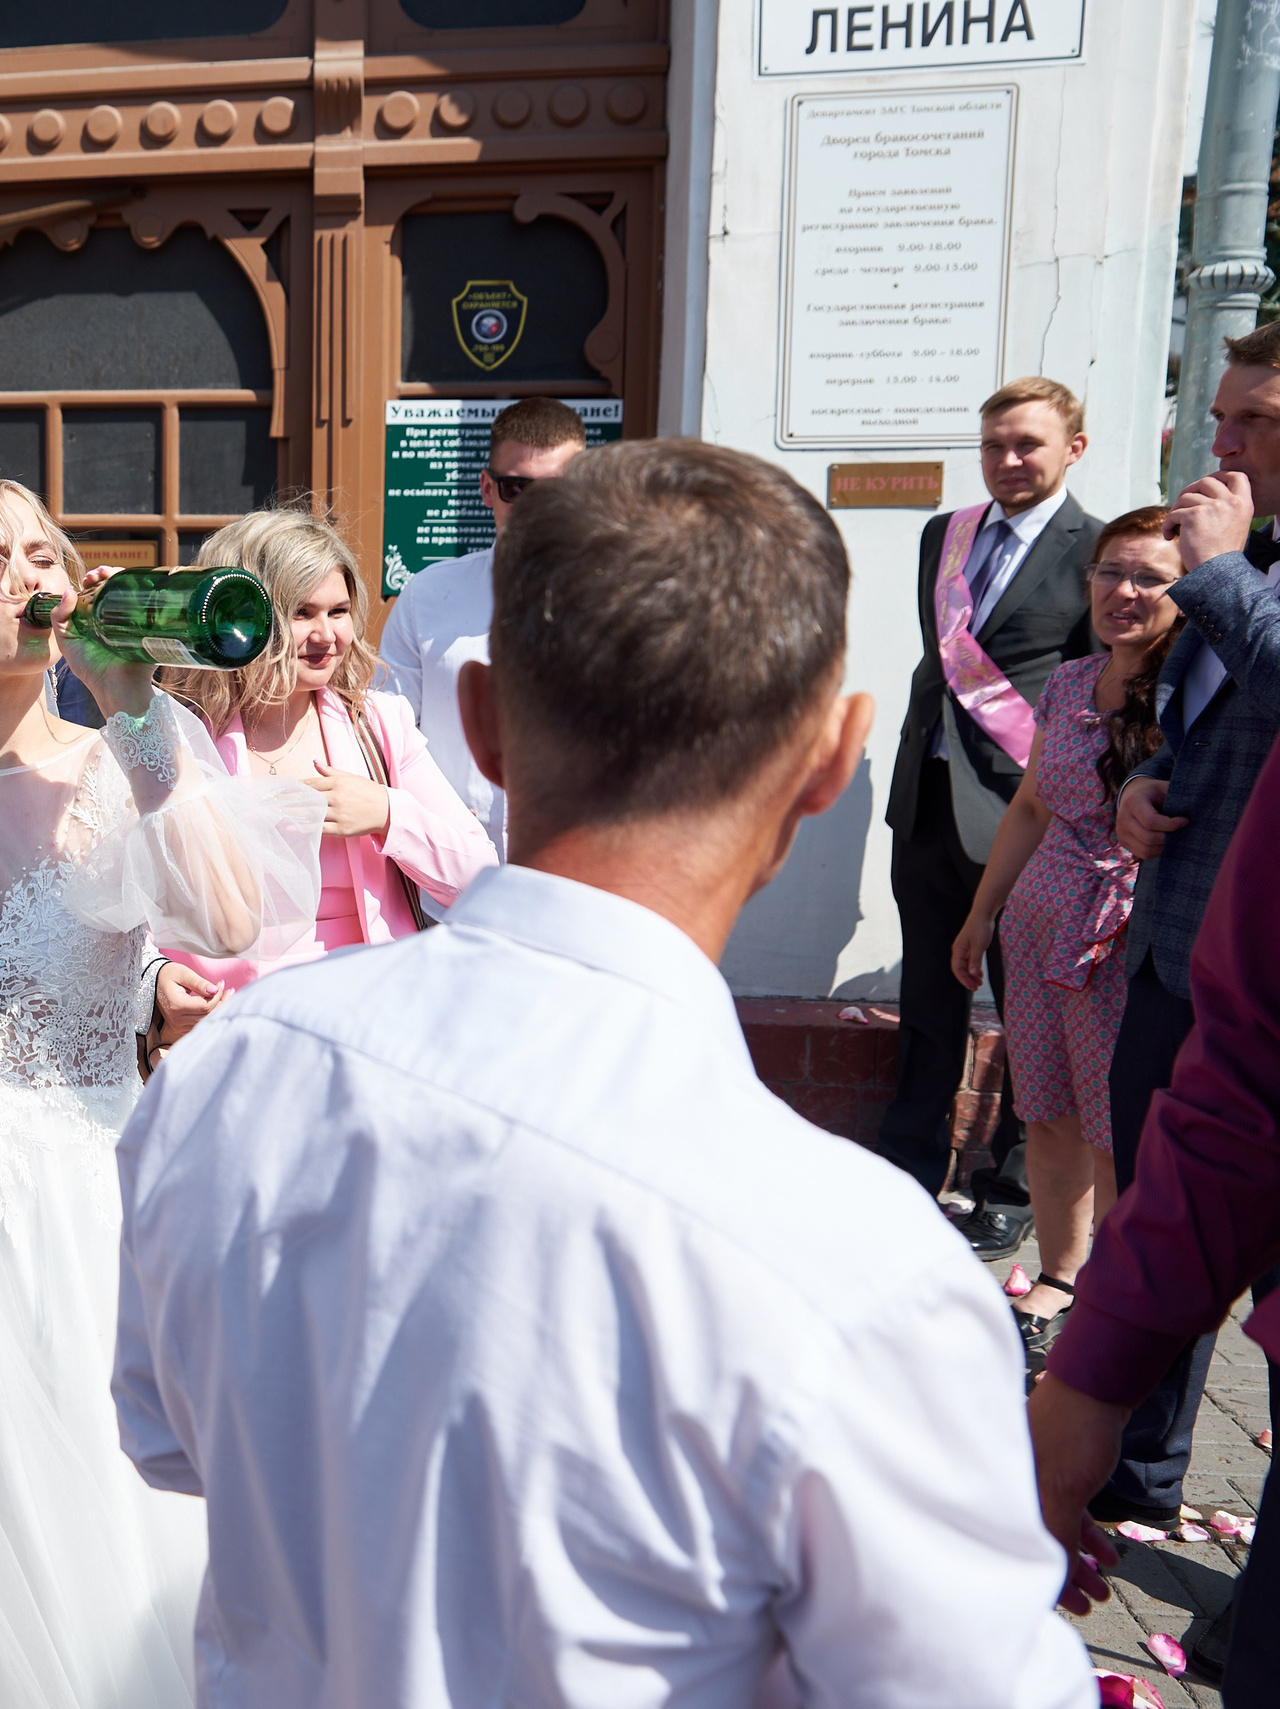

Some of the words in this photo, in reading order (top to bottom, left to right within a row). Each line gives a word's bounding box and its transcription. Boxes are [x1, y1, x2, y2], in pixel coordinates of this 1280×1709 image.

[805, 0, 1035, 55] ЛЕНИНА
[821, 134, 870, 147] Дворец
[874, 128, 986, 145] бракосочетаний
[853, 147, 900, 160] города
[904, 145, 951, 157] Томска
[406, 427, 428, 439] При
[429, 427, 491, 439] регистраци
[400, 440, 408, 448] в
[409, 440, 441, 448] целях
[443, 437, 490, 448] соблюде
[401, 450, 415, 459] во
[429, 461, 443, 469] из
[445, 461, 489, 469] помеще
[835, 476, 861, 492] НЕ
[865, 475, 940, 491] КУРИТЬ
[388, 489, 402, 497] не
[403, 488, 450, 497] осыпать
[426, 509, 440, 517] не
[417, 526, 430, 534] не
[416, 536, 430, 544] на
